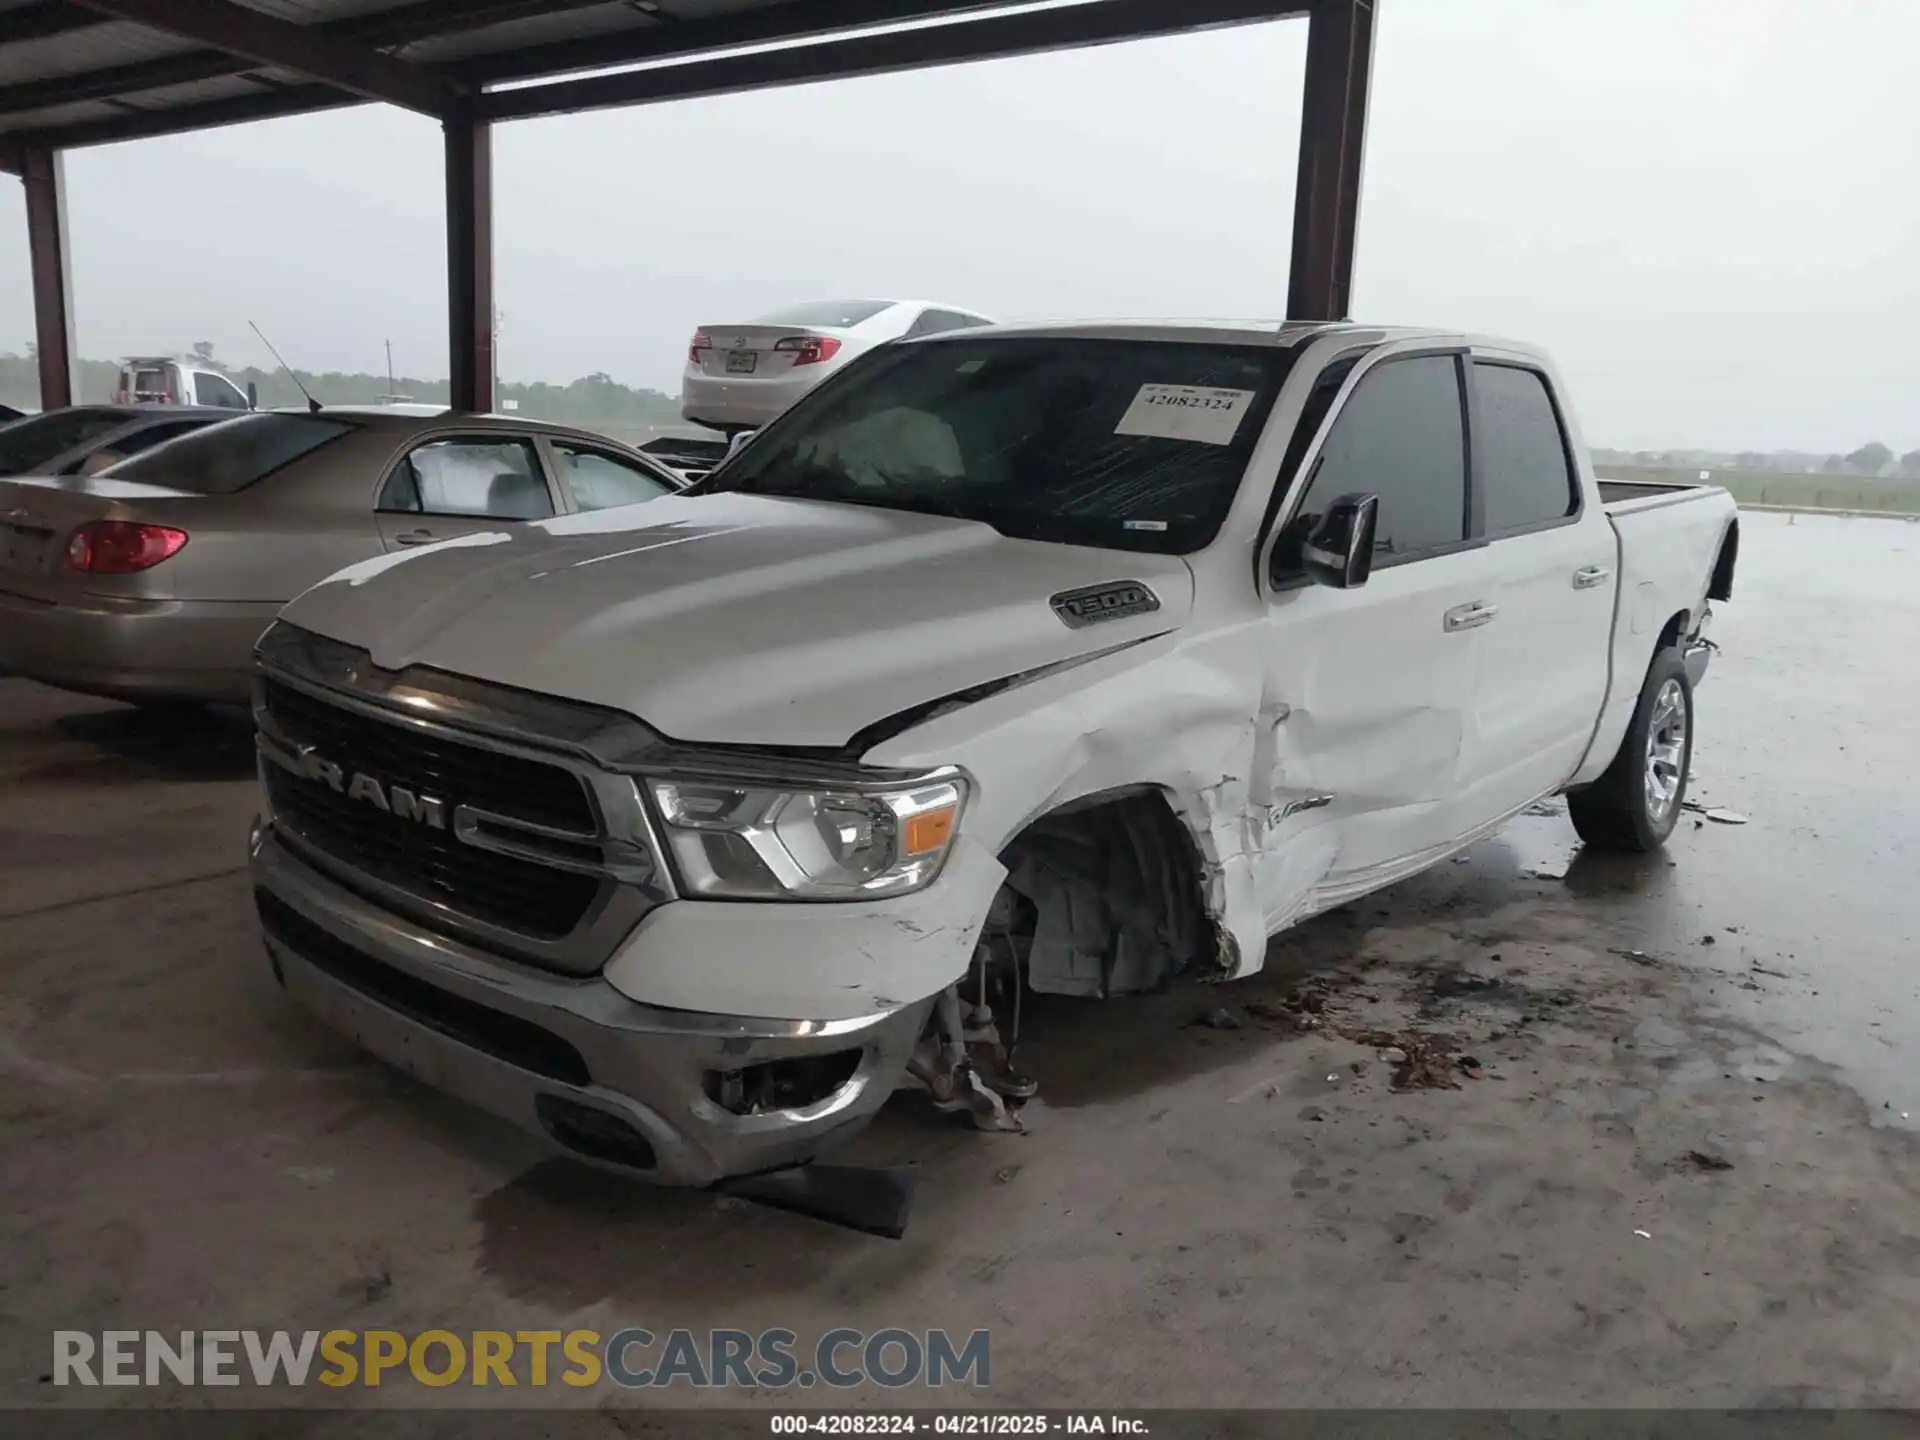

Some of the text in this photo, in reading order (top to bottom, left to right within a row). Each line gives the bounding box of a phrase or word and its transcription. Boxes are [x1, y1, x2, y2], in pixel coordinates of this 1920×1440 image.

[1144, 394, 1233, 411] 42082324
[1064, 588, 1142, 614] 1500
[302, 754, 446, 829] RAM
